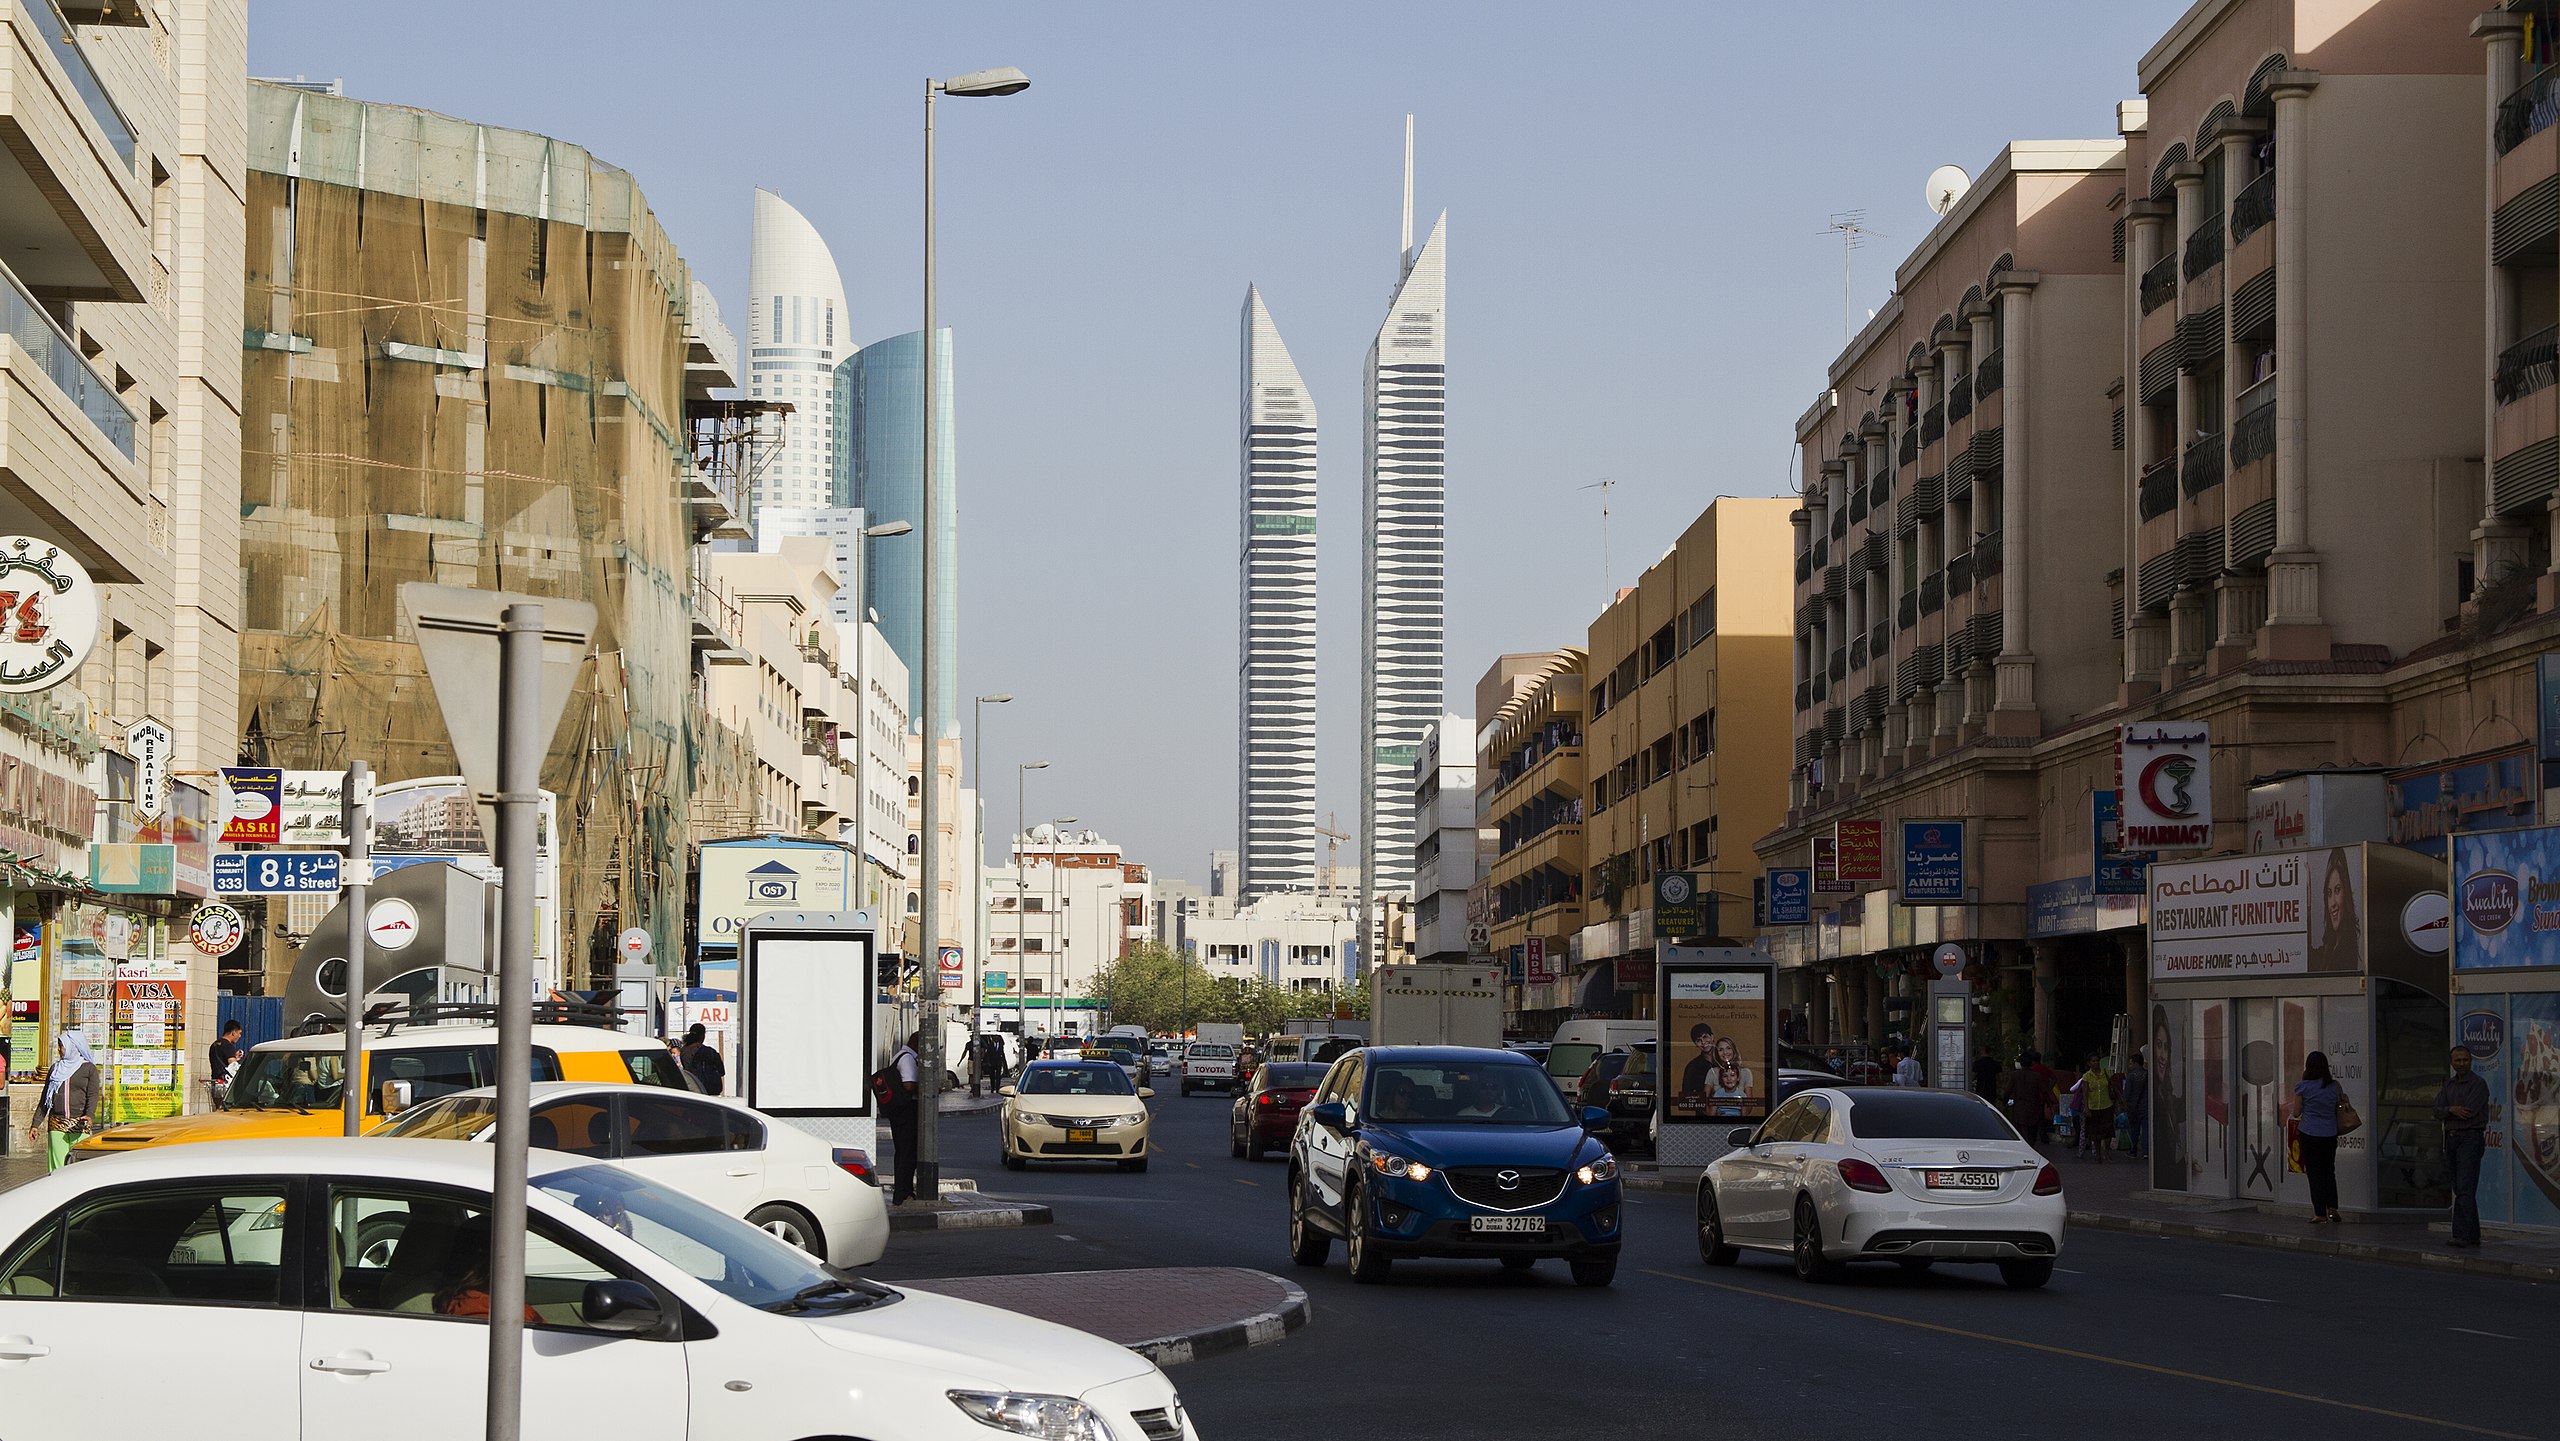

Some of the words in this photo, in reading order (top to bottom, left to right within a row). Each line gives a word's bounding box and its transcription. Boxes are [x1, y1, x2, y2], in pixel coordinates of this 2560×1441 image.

[132, 725, 165, 744] MOBILE
[2125, 726, 2206, 750] صيدلية
[145, 738, 154, 809] REPAIRING
[223, 821, 276, 833] KASRI
[2128, 824, 2210, 846] PHARMACY
[215, 859, 244, 868] المنطقة
[299, 857, 338, 875] شارع
[1907, 850, 1959, 866] عمريت
[145, 865, 167, 875] ATM
[259, 858, 280, 888] 8
[1840, 862, 1881, 877] Garden
[217, 877, 243, 890] 333
[283, 872, 296, 887] a
[299, 876, 337, 889] Street
[1907, 877, 1960, 887] AMRIT
[2156, 869, 2250, 902] المطاعم
[762, 885, 784, 896] OST
[2465, 881, 2515, 917] Kwality
[194, 906, 238, 929] KASRI
[1657, 917, 1695, 926] CREATURES
[2156, 905, 2229, 931] RESTAURANT
[2231, 899, 2300, 926] FURNITURE
[389, 922, 406, 930] RTA
[712, 916, 752, 934] OS
[2037, 914, 2057, 933] AMRIT
[192, 931, 238, 954] CARGO
[1470, 928, 1488, 941] 24
[1530, 939, 1539, 975] BIRDS
[2166, 955, 2204, 971] DANUBE
[2205, 953, 2233, 969] HOME
[118, 966, 149, 978] Kasri
[127, 983, 174, 999] VISA
[136, 1002, 154, 1010] OMAN
[700, 1007, 729, 1022] ARJ
[2463, 1017, 2501, 1049] Kwality
[1194, 1066, 1226, 1074] TOYOTA
[2345, 1065, 2363, 1079] NOW
[1928, 1175, 1938, 1184] 14
[1960, 1174, 1996, 1186] 45516
[1505, 1217, 1544, 1231] 32762
